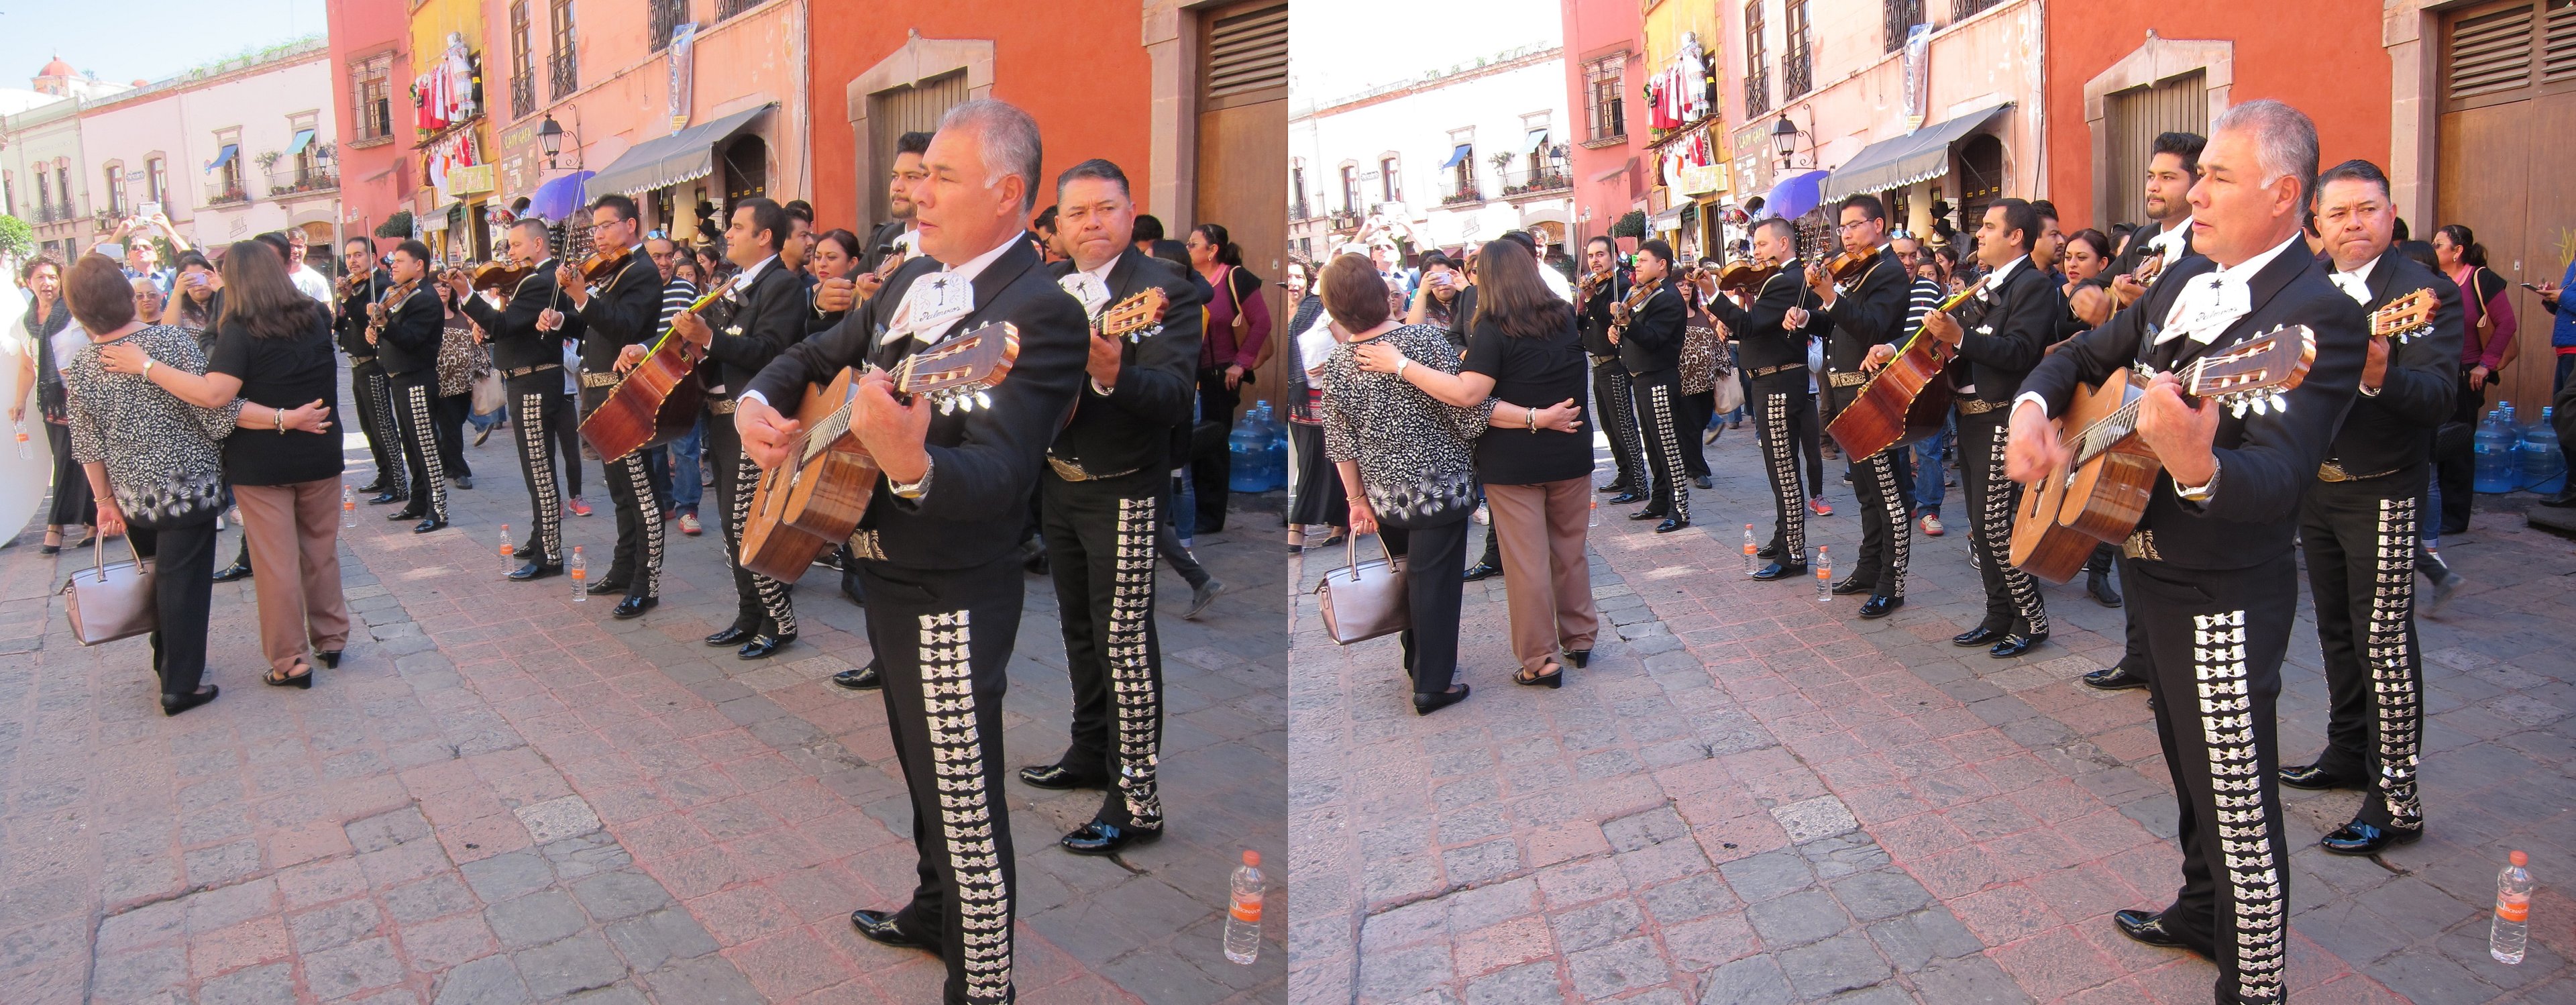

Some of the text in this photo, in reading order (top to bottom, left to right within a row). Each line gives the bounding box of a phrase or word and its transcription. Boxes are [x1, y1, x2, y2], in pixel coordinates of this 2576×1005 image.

[504, 127, 532, 149] LADY GAFA
[1739, 127, 1766, 148] LADY GAFA
[919, 306, 961, 322] Palmeros
